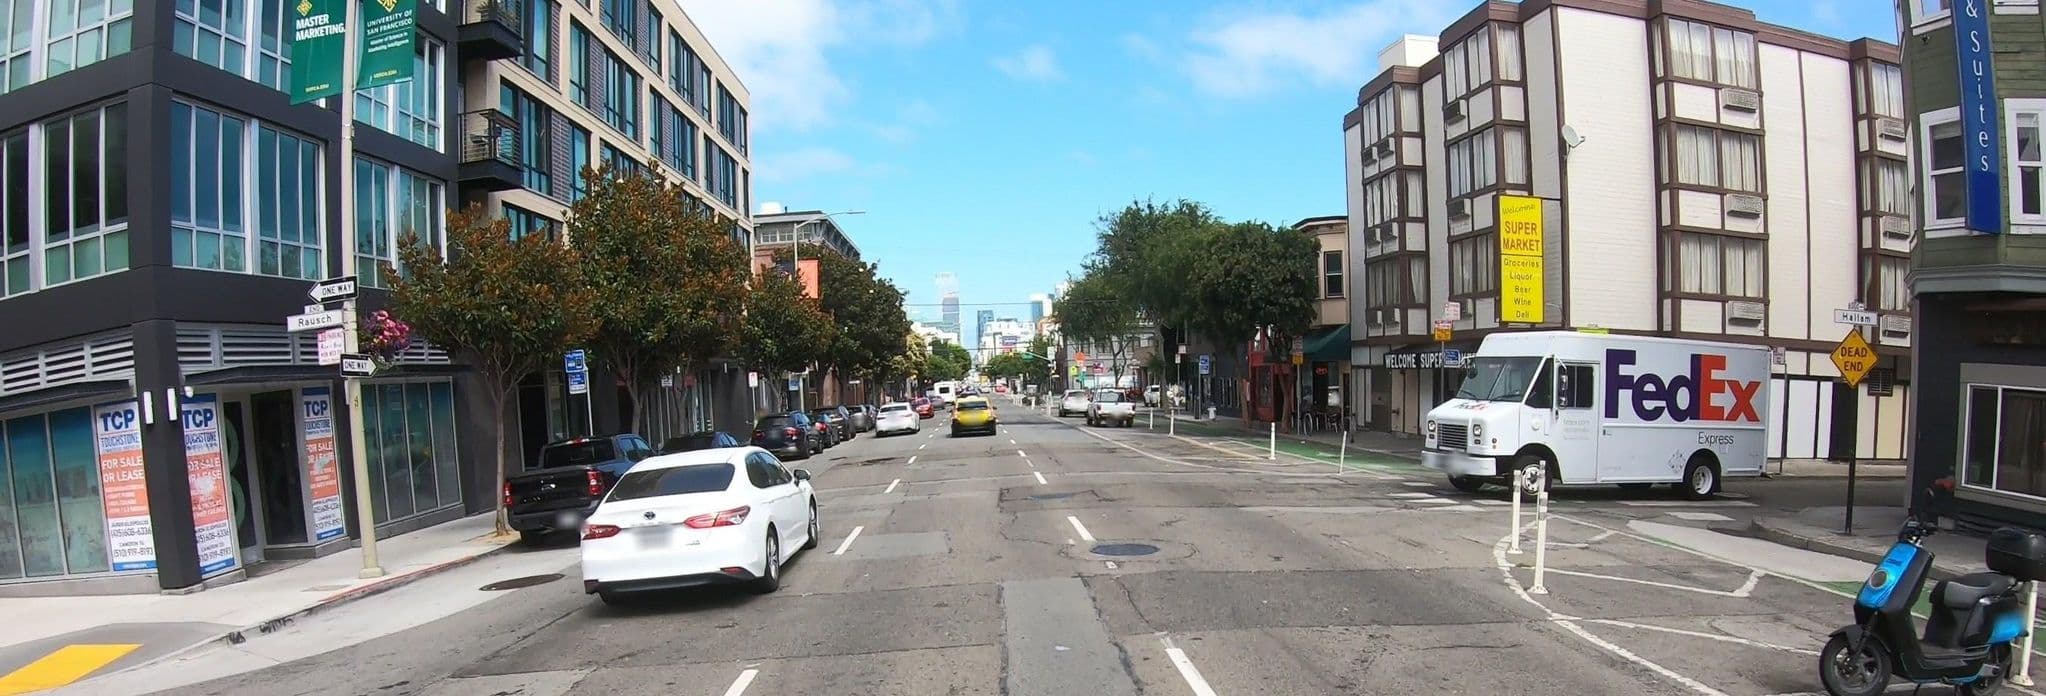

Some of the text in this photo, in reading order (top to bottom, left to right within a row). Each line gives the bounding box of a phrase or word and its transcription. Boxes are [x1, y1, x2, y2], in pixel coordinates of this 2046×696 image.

[1966, 0, 1978, 18] &
[296, 14, 329, 30] MASTER
[367, 9, 412, 27] UNIVERSITY OF
[367, 18, 412, 35] SAN FRANCISCO
[1970, 31, 1989, 172] Suites
[1504, 221, 1538, 235] SUPER
[1502, 238, 1540, 252] MARKET
[1504, 258, 1540, 268] Groceries
[1509, 272, 1533, 282] Liquor
[322, 283, 353, 296] ONE WAY
[1513, 298, 1532, 306] Wine
[298, 315, 332, 327] Rausch
[1516, 310, 1530, 318] Deli
[1842, 312, 1871, 323] Hallam
[1840, 347, 1868, 358] DEAD
[344, 361, 367, 369] ONE WAY
[1385, 353, 1416, 369] WELCOME
[1844, 361, 1864, 372] END
[1605, 349, 1761, 422] FedEx
[304, 400, 328, 417] TCP
[100, 408, 135, 432] TCP
[182, 408, 214, 429] TCP
[101, 432, 139, 449] TOUCHSTONE
[1698, 431, 1734, 446] Express
[102, 455, 143, 470] FOR SALE
[200, 457, 221, 469] SALE
[103, 469, 145, 483] OR LEASE
